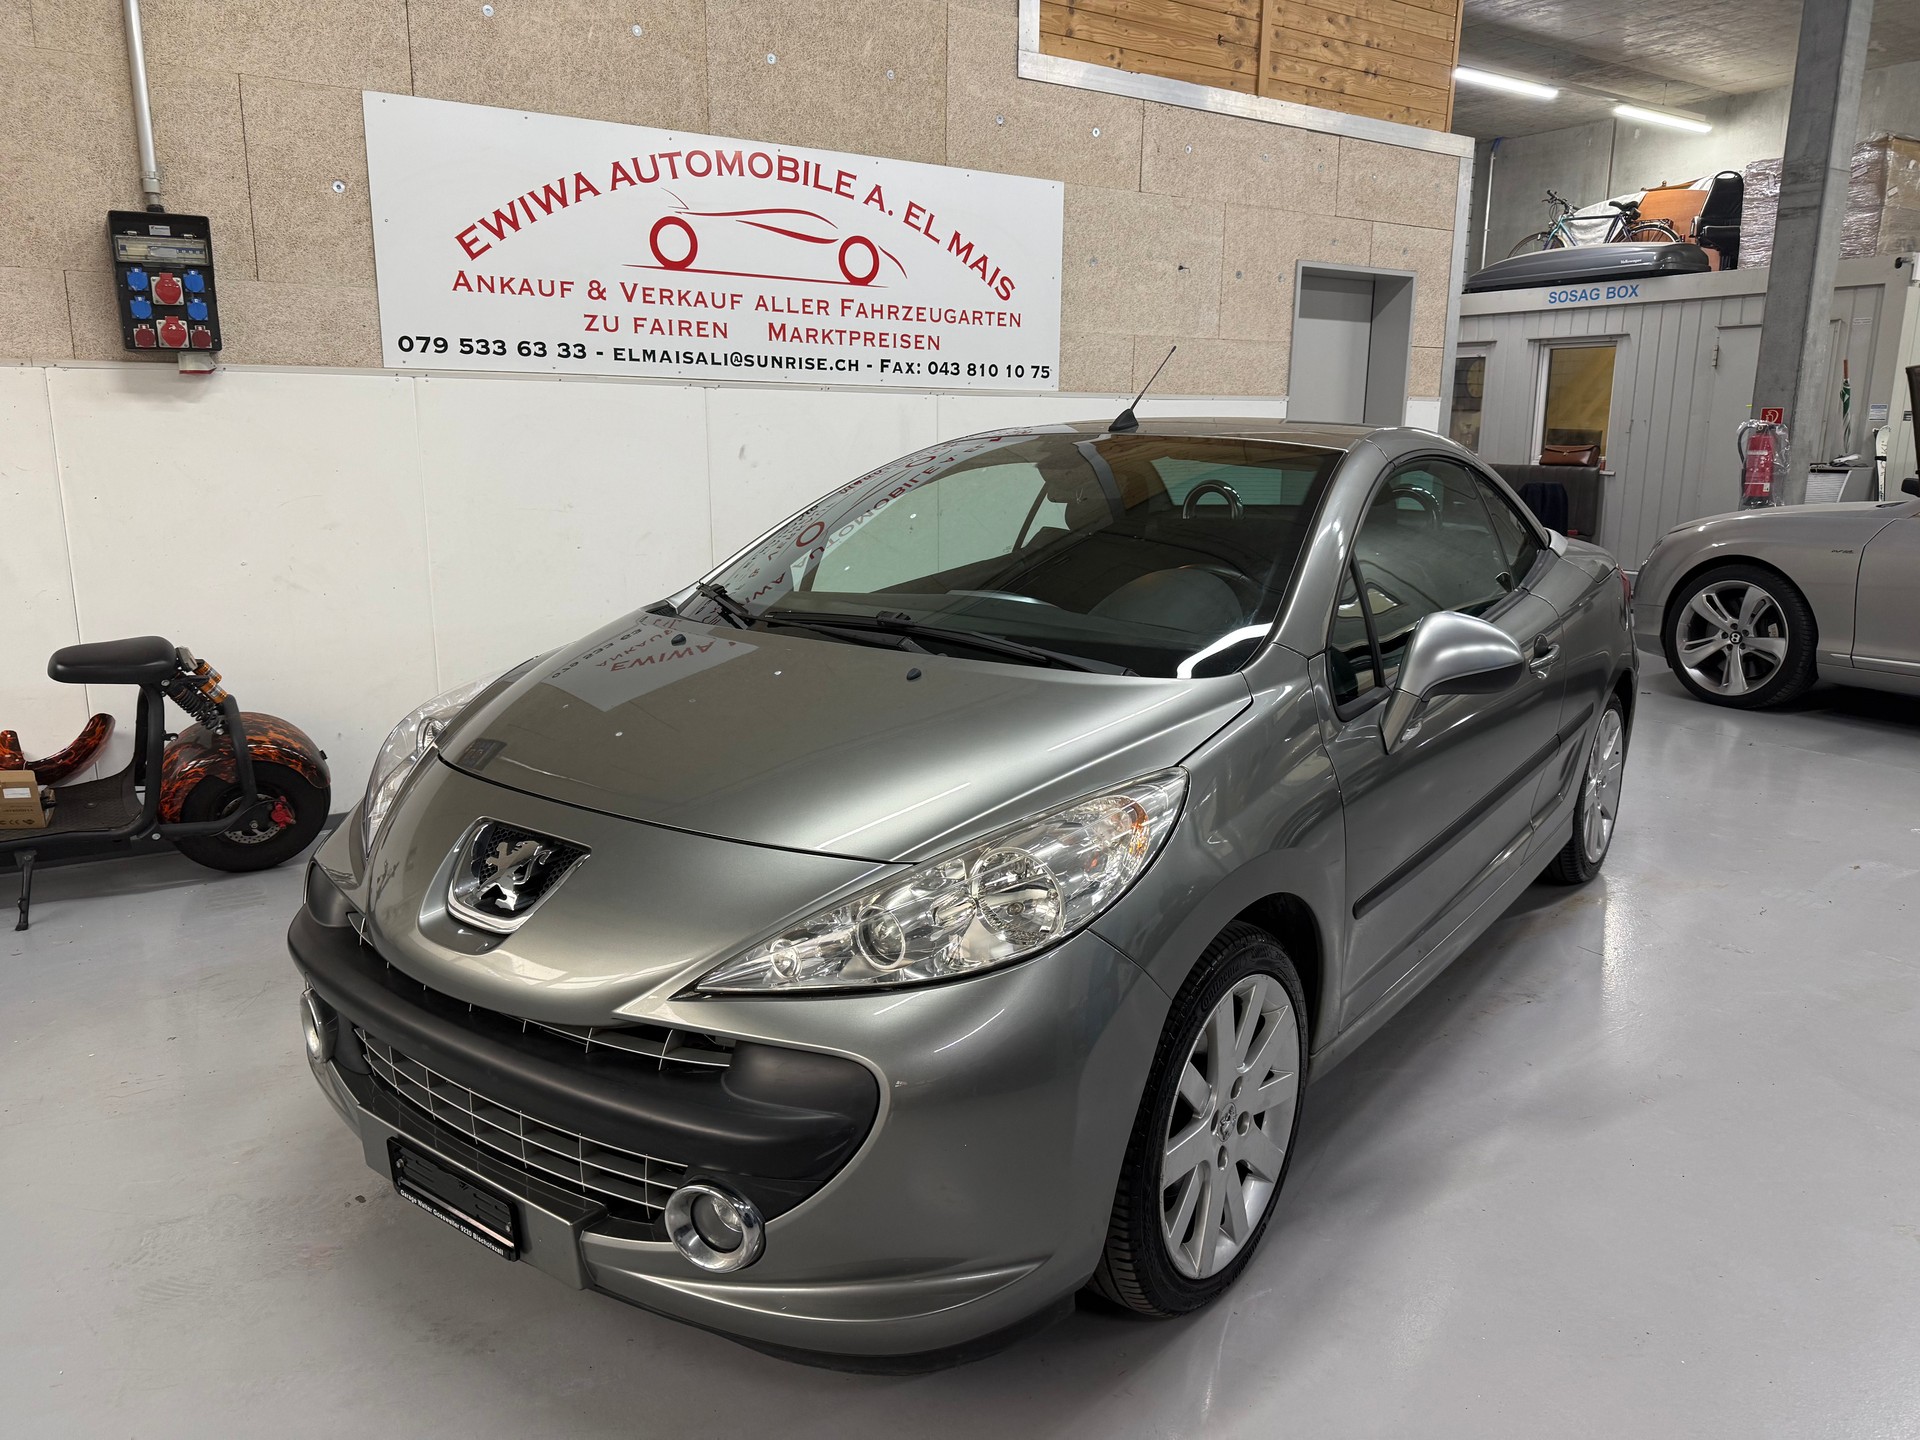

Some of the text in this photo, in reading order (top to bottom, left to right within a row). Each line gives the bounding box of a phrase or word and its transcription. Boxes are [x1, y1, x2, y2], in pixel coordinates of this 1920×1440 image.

[456, 150, 1016, 302] EWIWA AUTOMOBILE A. EL MAIS
[453, 271, 1022, 328] ANKAUF & VERKAUF ALLER FAHRZEUGARTEN
[1548, 285, 1640, 305] SOSAG BOX
[584, 314, 940, 351] ZU FAIREN MARKTPREISEN
[398, 336, 448, 354] 079
[459, 338, 508, 356] 533
[517, 341, 548, 358] 63
[557, 343, 587, 360] 33
[927, 361, 961, 377] 043
[967, 362, 999, 379] 810
[1006, 364, 1025, 379] 10
[1030, 365, 1051, 380] 75
